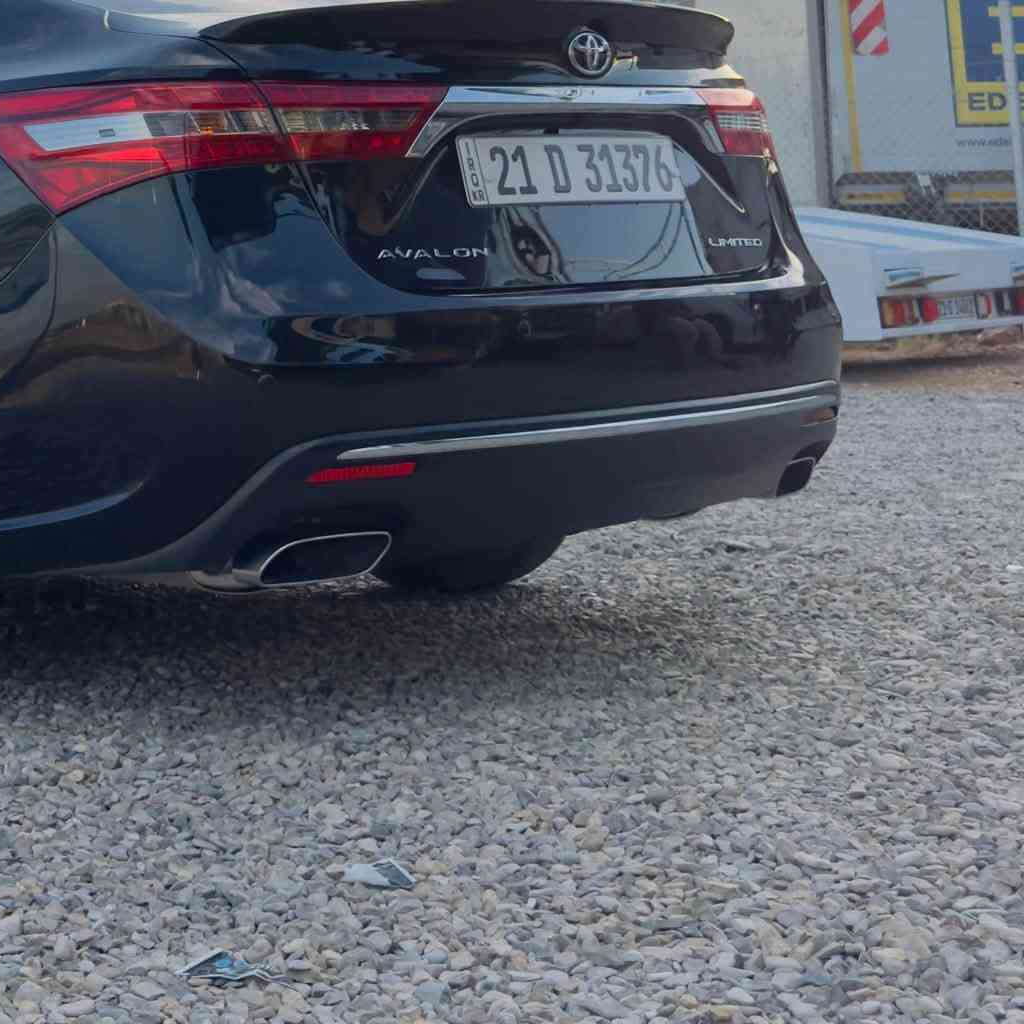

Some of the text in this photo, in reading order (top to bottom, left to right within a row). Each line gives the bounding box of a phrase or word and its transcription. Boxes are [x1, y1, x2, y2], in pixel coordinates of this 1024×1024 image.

[489, 144, 674, 195] 21 D 31376
[708, 237, 762, 247] LIMITED
[377, 246, 489, 260] AVALON
